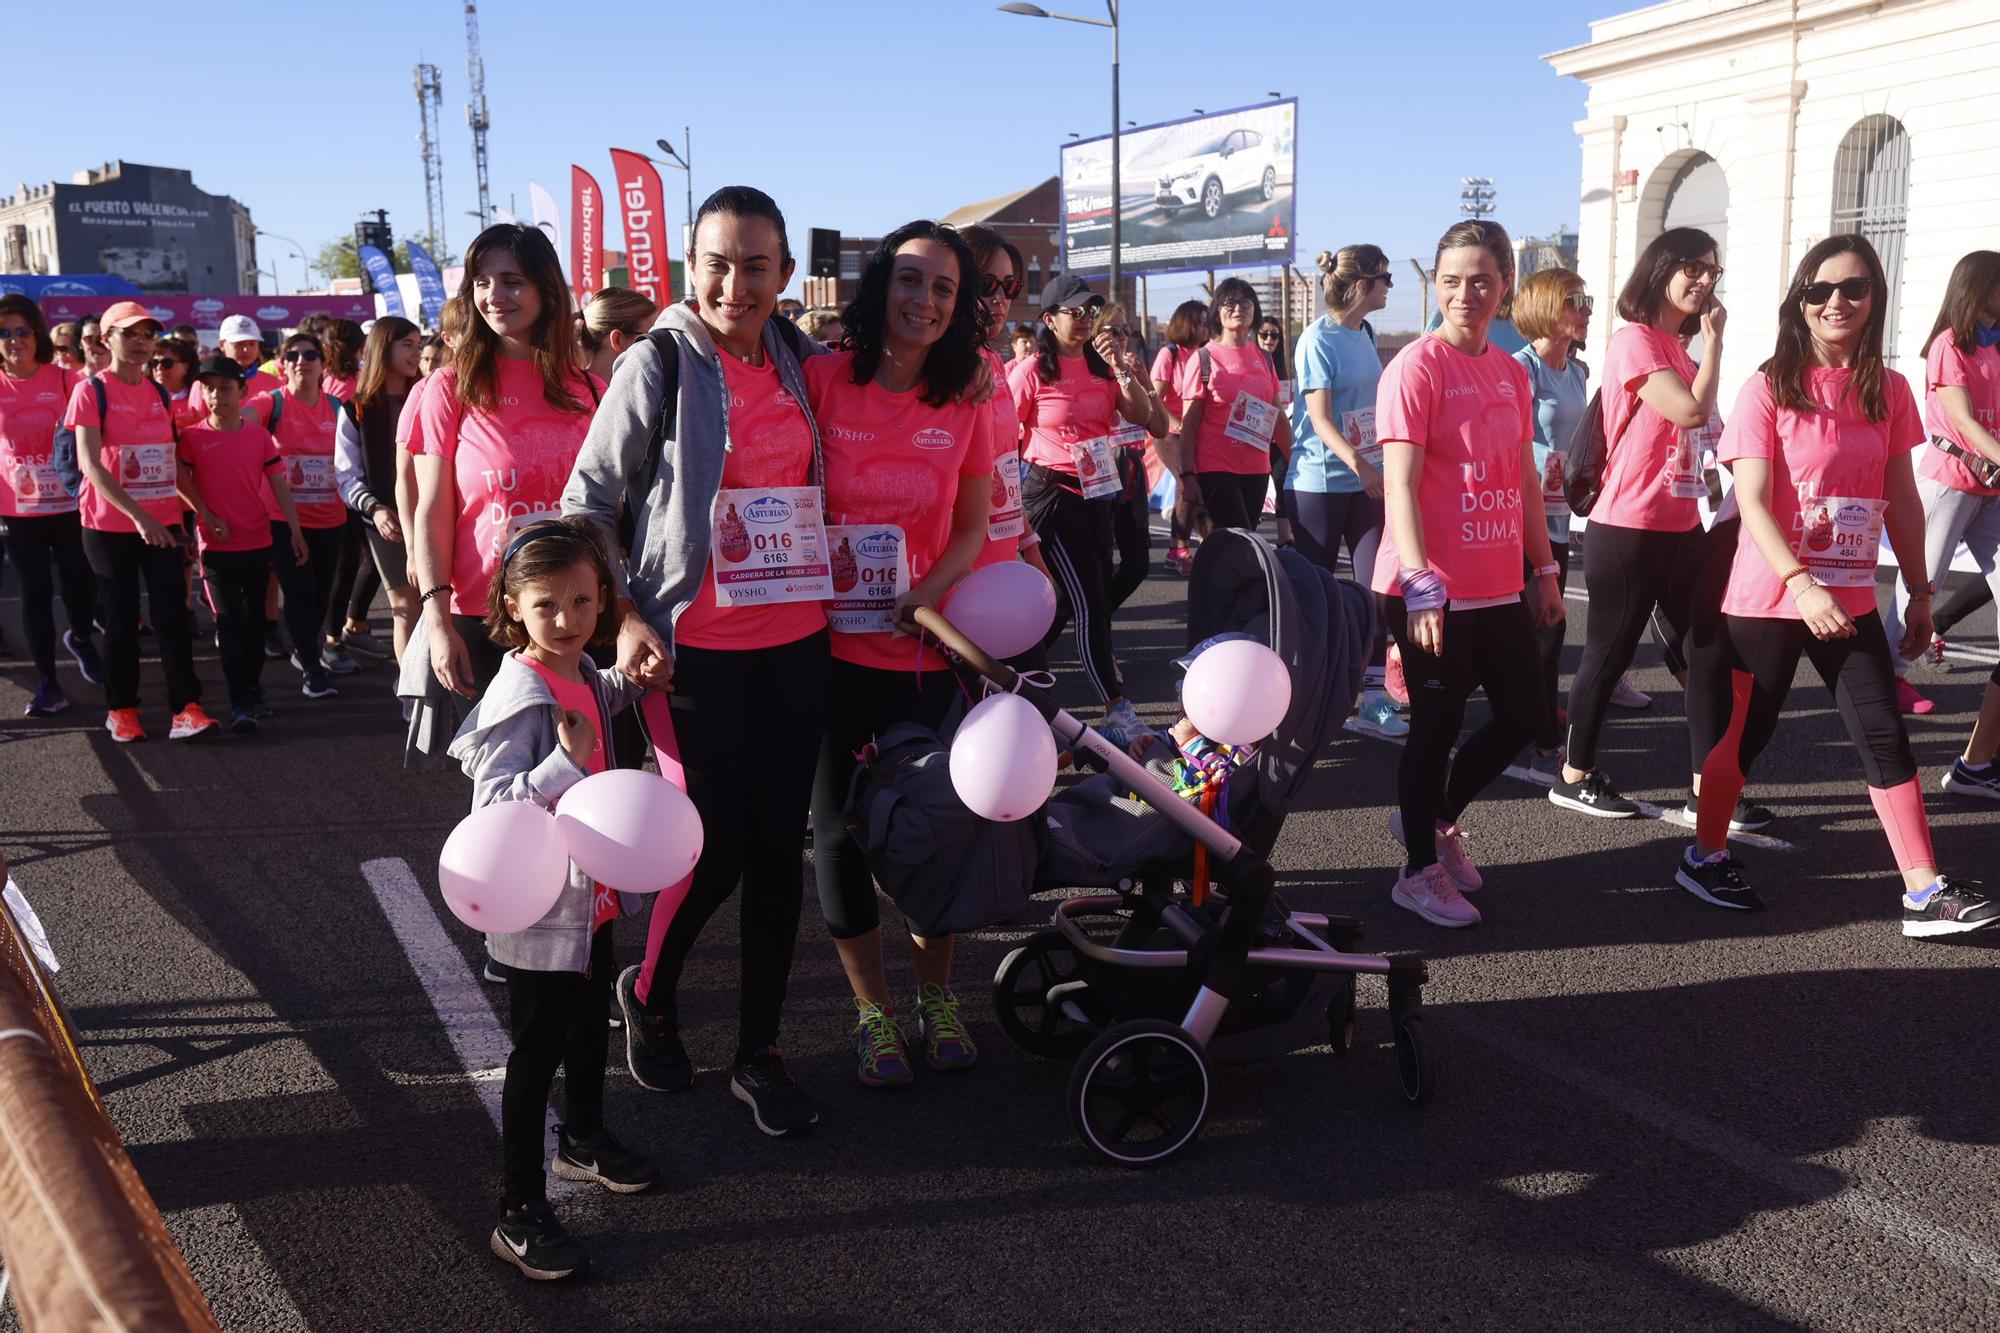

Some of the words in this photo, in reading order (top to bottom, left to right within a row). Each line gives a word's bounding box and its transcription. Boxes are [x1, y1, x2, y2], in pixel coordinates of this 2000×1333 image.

[84, 200, 130, 215] PUERTO
[826, 425, 875, 441] OYSHO
[1459, 460, 1486, 483] TU
[481, 468, 517, 492] TU
[1461, 517, 1519, 542] SUMA
[754, 532, 792, 550] 016
[1836, 532, 1863, 546] 016
[763, 552, 788, 564] 6163
[861, 567, 897, 582] 016
[729, 586, 767, 599] OYSHO
[793, 583, 825, 592] Santander
[868, 586, 892, 596] 6164
[830, 616, 866, 625] OYSHO
